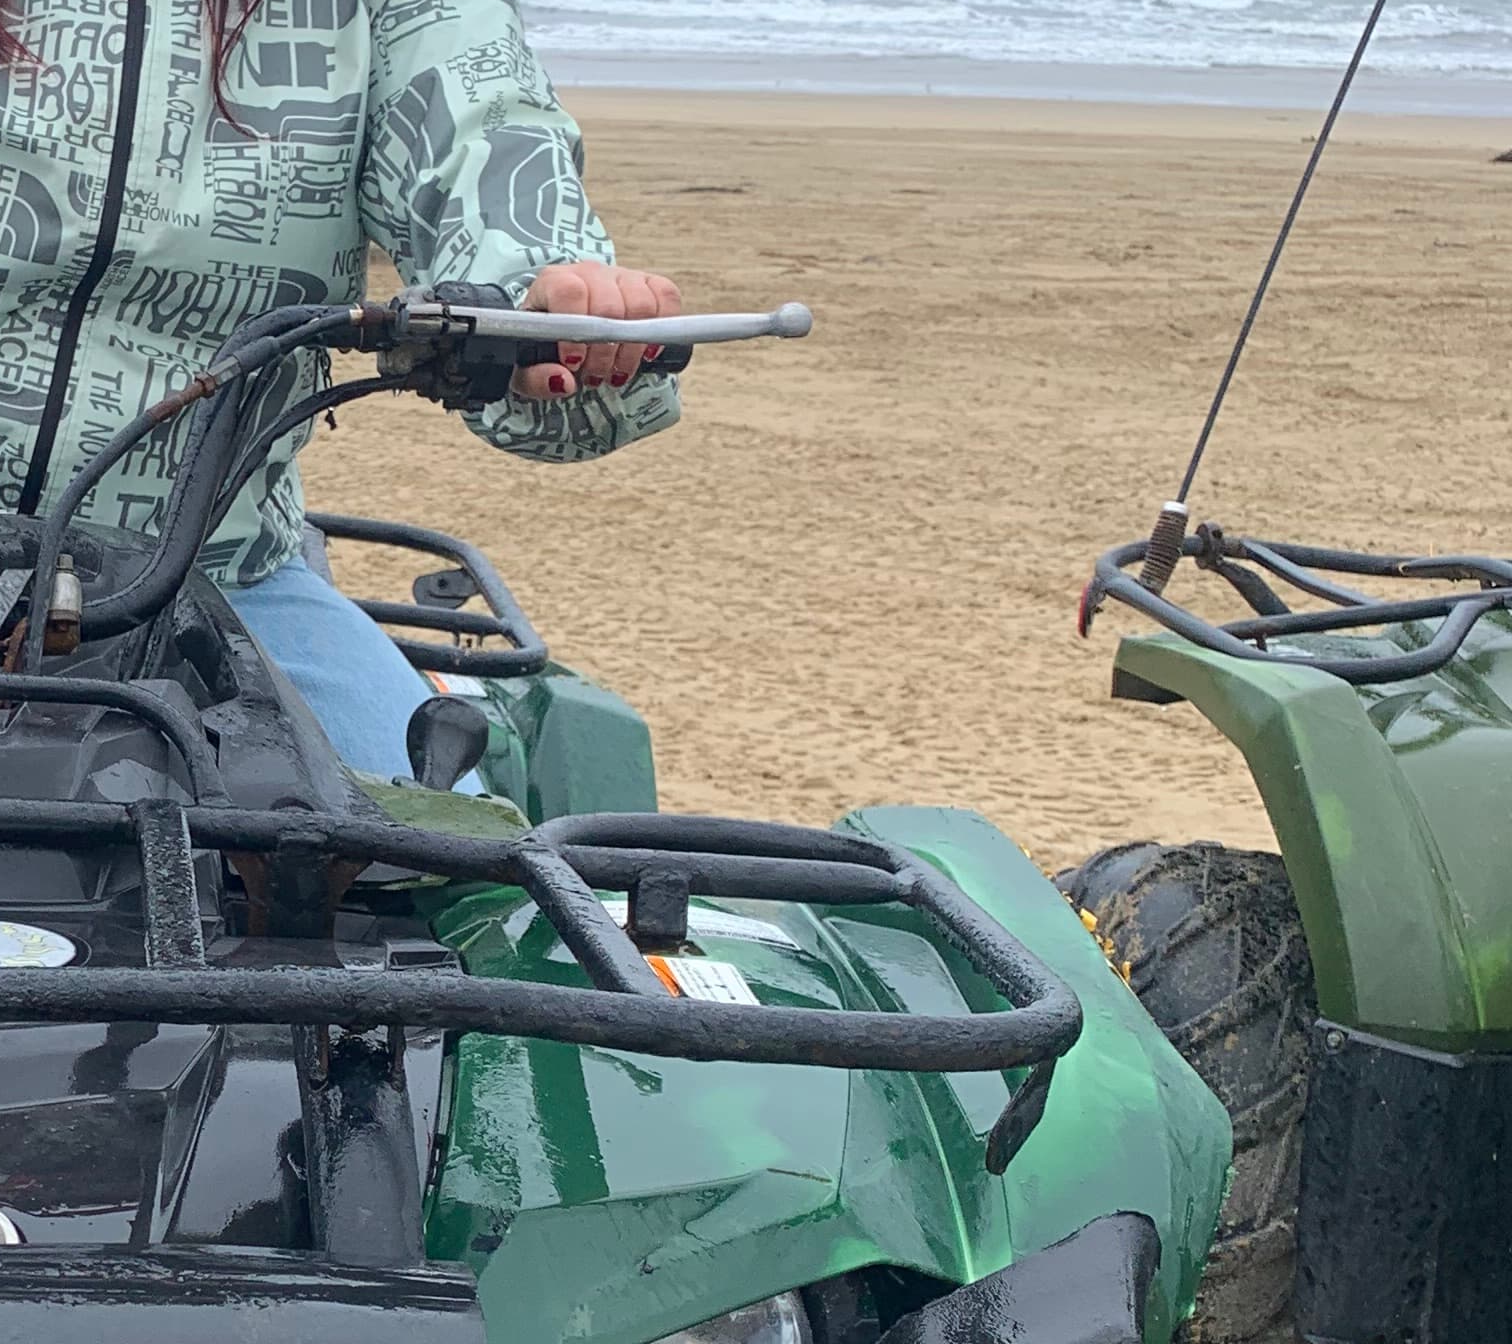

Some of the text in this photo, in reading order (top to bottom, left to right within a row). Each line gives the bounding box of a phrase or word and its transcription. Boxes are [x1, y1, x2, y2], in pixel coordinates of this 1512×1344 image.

[5, 131, 85, 166] THE
[7, 114, 115, 155] ORTH
[207, 259, 277, 278] THE
